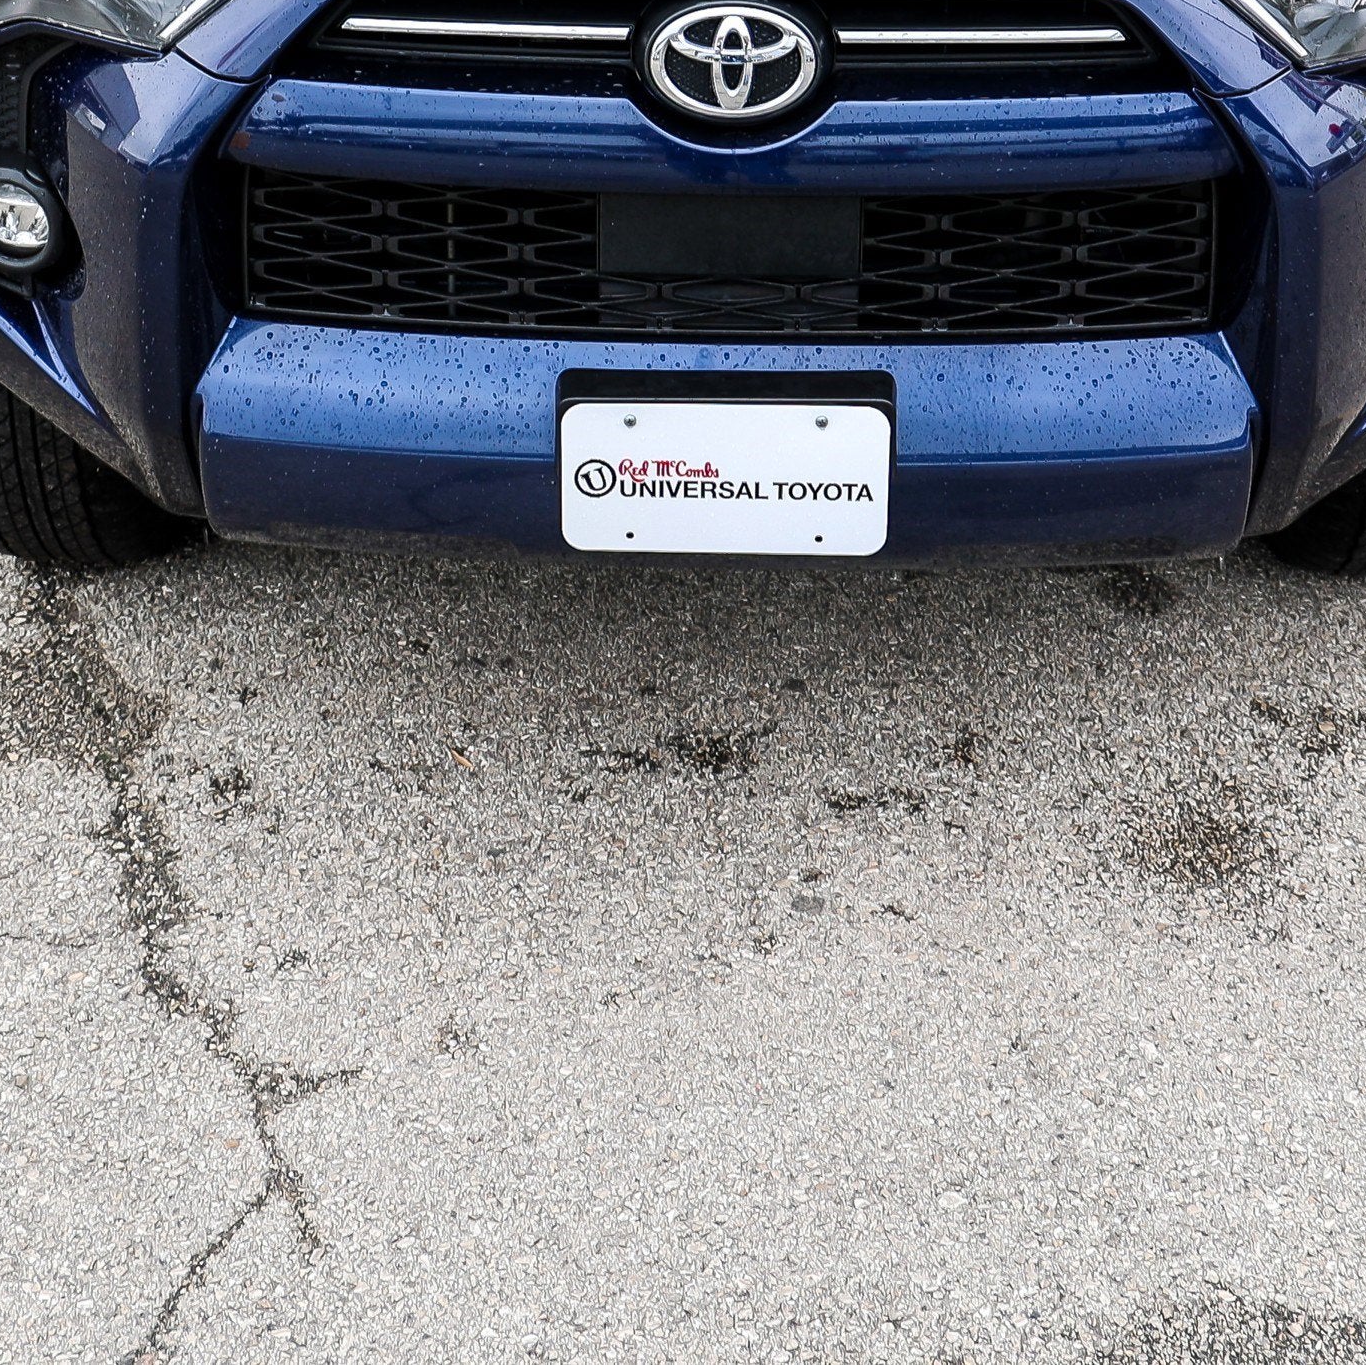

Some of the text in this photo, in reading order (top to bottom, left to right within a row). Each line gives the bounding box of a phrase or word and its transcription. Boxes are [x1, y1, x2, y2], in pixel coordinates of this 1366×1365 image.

[619, 458, 719, 483] Red McCombs
[620, 479, 874, 502] UNIVERSAL TOYOTA
